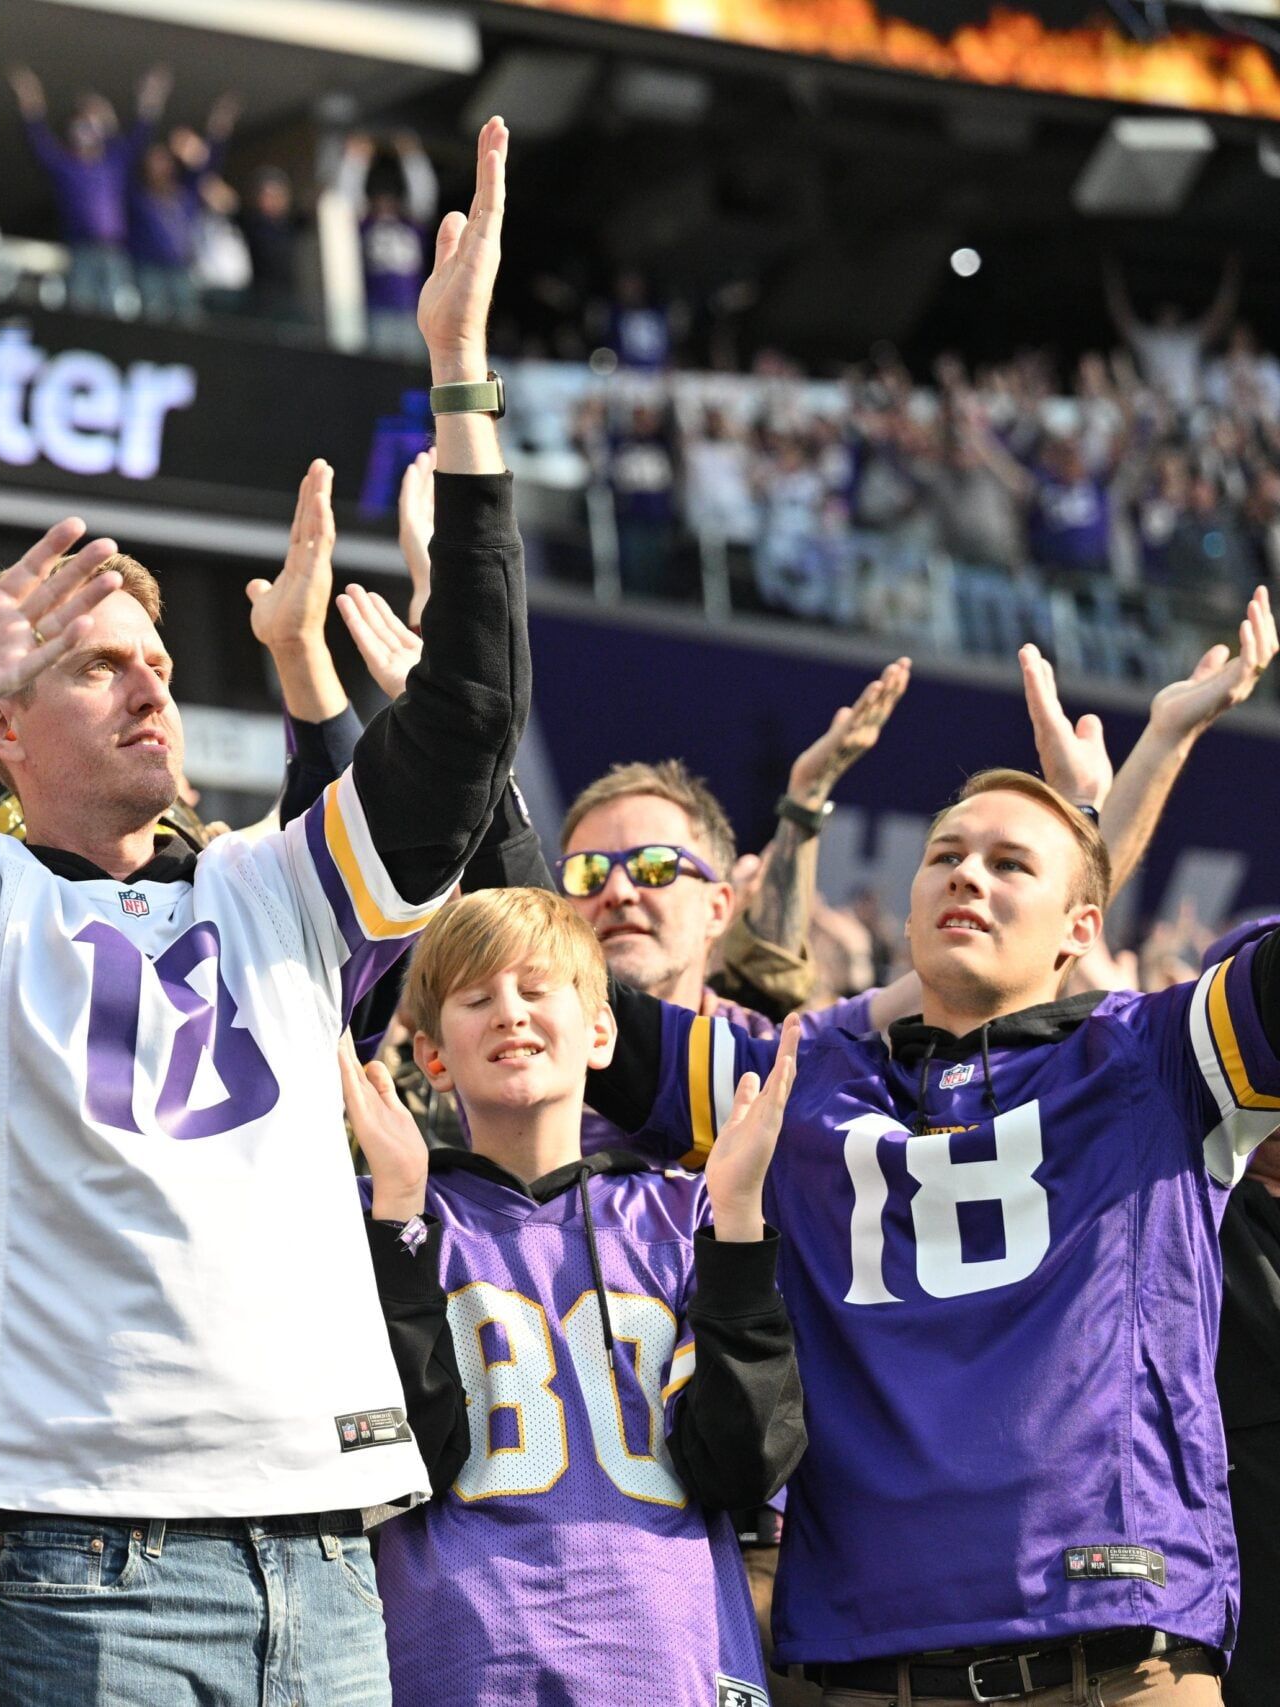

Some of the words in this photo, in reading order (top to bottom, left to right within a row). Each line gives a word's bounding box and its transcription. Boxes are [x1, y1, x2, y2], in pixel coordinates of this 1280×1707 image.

[124, 899, 148, 913] NFL
[71, 919, 281, 1141] 18
[944, 1072, 965, 1085] NFL
[833, 1098, 1051, 1305] 18
[446, 1280, 689, 1509] 80
